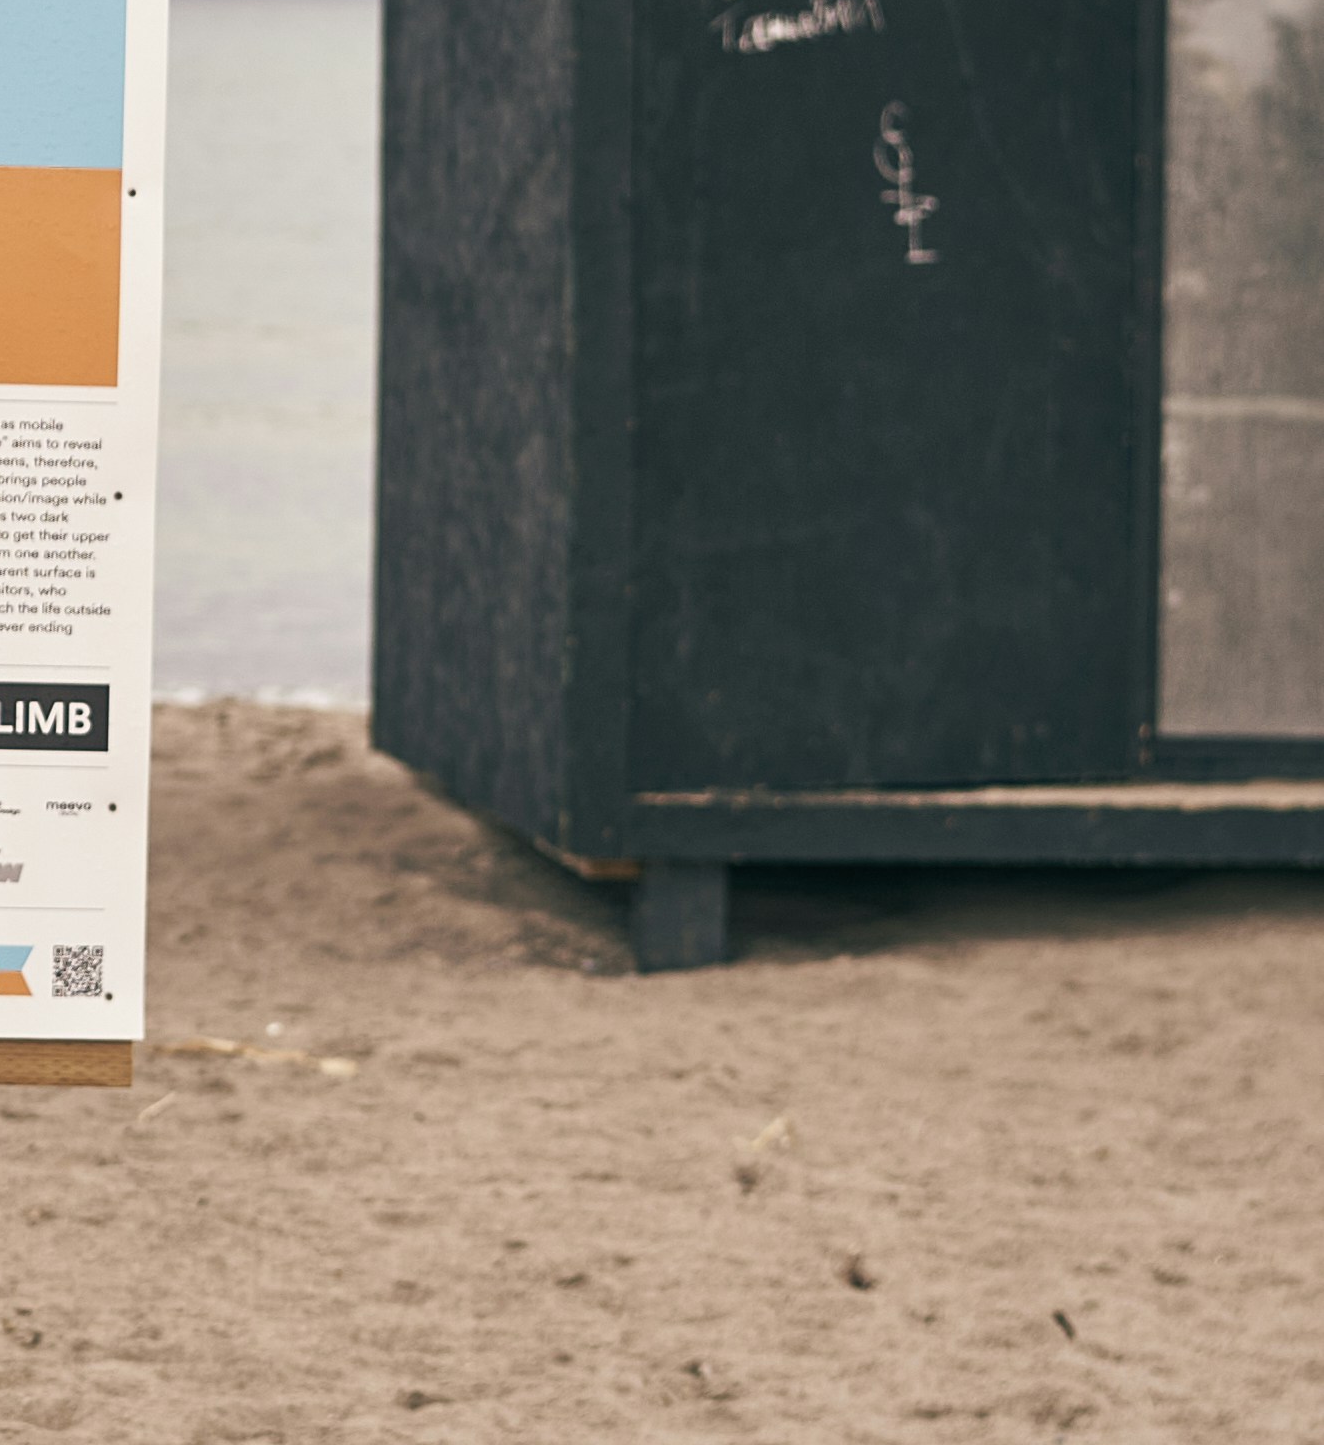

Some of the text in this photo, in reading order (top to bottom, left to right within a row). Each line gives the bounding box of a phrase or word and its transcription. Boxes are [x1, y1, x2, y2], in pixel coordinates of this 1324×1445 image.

[19, 419, 64, 432] mobile
[11, 436, 42, 449] aims
[63, 438, 102, 450] reveal
[41, 475, 87, 488] people
[72, 493, 107, 505] while
[11, 511, 37, 523] two
[40, 511, 69, 523] dark
[13, 530, 35, 543] get
[39, 529, 68, 541] their
[72, 533, 110, 544] upper
[14, 550, 39, 559] one
[33, 565, 82, 578] surface
[38, 584, 67, 596] who
[18, 603, 38, 614] the
[42, 602, 61, 614] life
[64, 604, 110, 615] outside
[28, 621, 73, 635] ending
